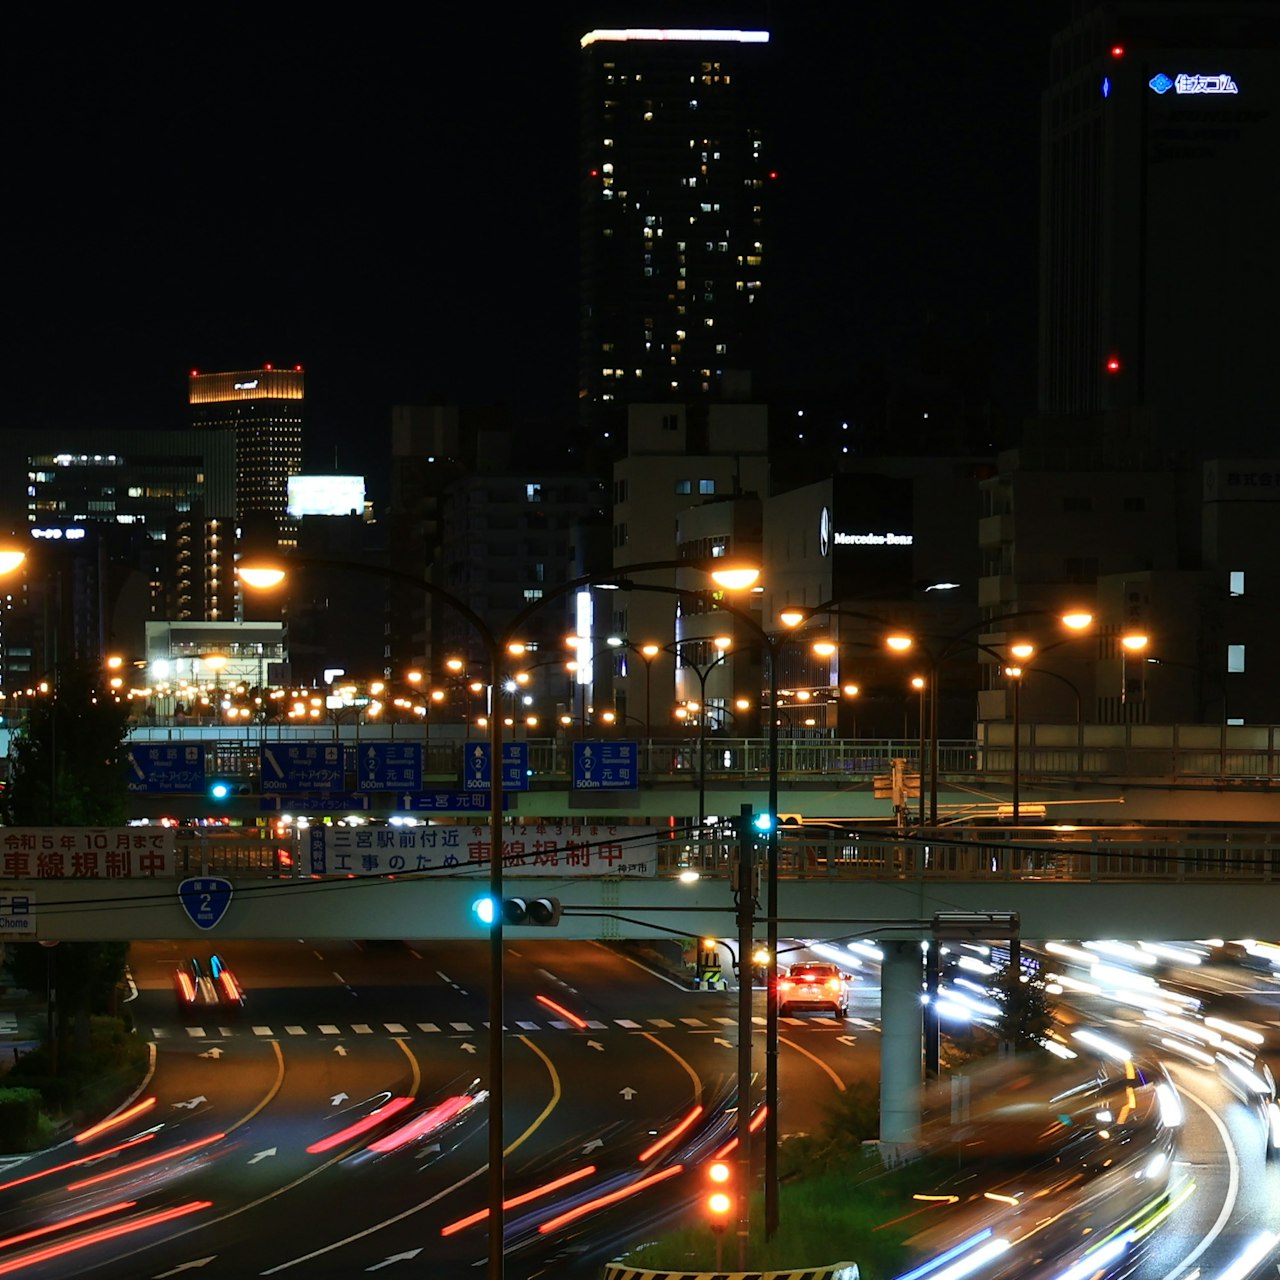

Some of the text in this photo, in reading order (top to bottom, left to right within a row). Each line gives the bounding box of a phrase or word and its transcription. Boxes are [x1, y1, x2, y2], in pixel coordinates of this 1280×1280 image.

[834, 532, 913, 545] Mercedes-Benz
[385, 769, 415, 780] 元町
[601, 768, 630, 779] 元町
[263, 781, 287, 789] 500m
[361, 781, 384, 789] 500m
[576, 780, 600, 788] 500m
[455, 794, 486, 808] 元町
[472, 826, 617, 836] 令12年3月まで
[4, 834, 164, 850] 令和5年10月まで
[334, 829, 460, 848] 三宮駅前付近
[467, 840, 623, 867] 車線規制中
[3, 851, 165, 879] 車線規制中
[335, 854, 459, 871] 工事のため
[200, 894, 211, 911] 2
